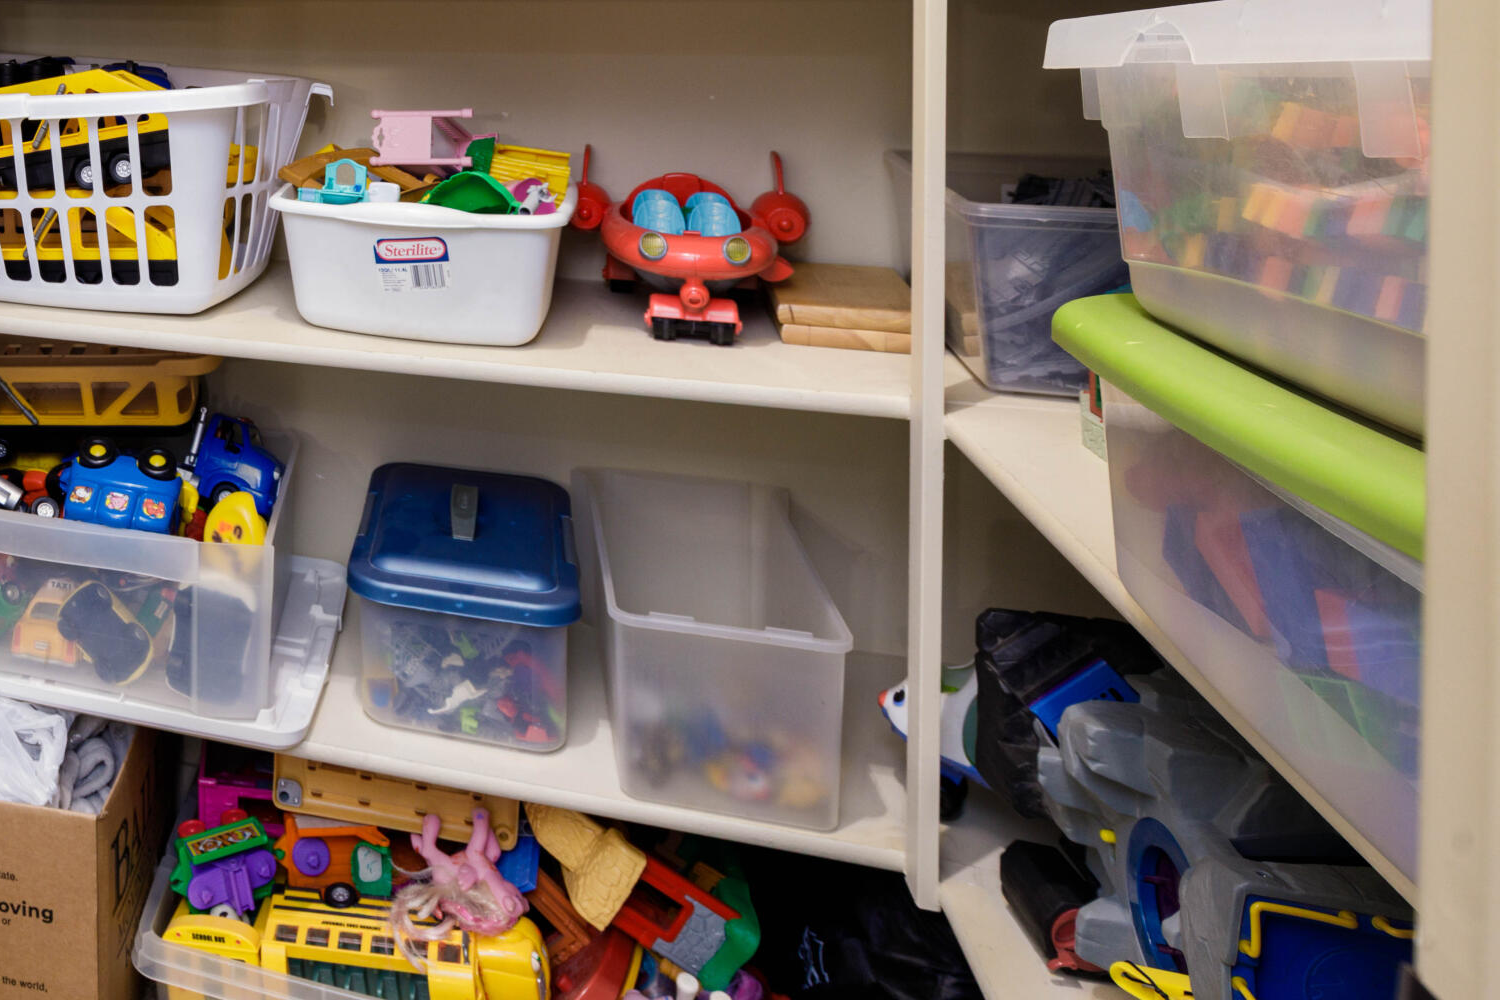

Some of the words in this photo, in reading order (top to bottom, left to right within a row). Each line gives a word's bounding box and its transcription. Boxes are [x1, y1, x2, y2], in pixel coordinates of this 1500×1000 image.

[384, 243, 438, 257] Sterilite
[51, 581, 72, 590] TAXI
[1, 917, 12, 926] or
[192, 932, 213, 943] SCHOOL
[214, 935, 226, 944] BUS
[2, 977, 16, 986] the
[20, 979, 48, 992] world,
